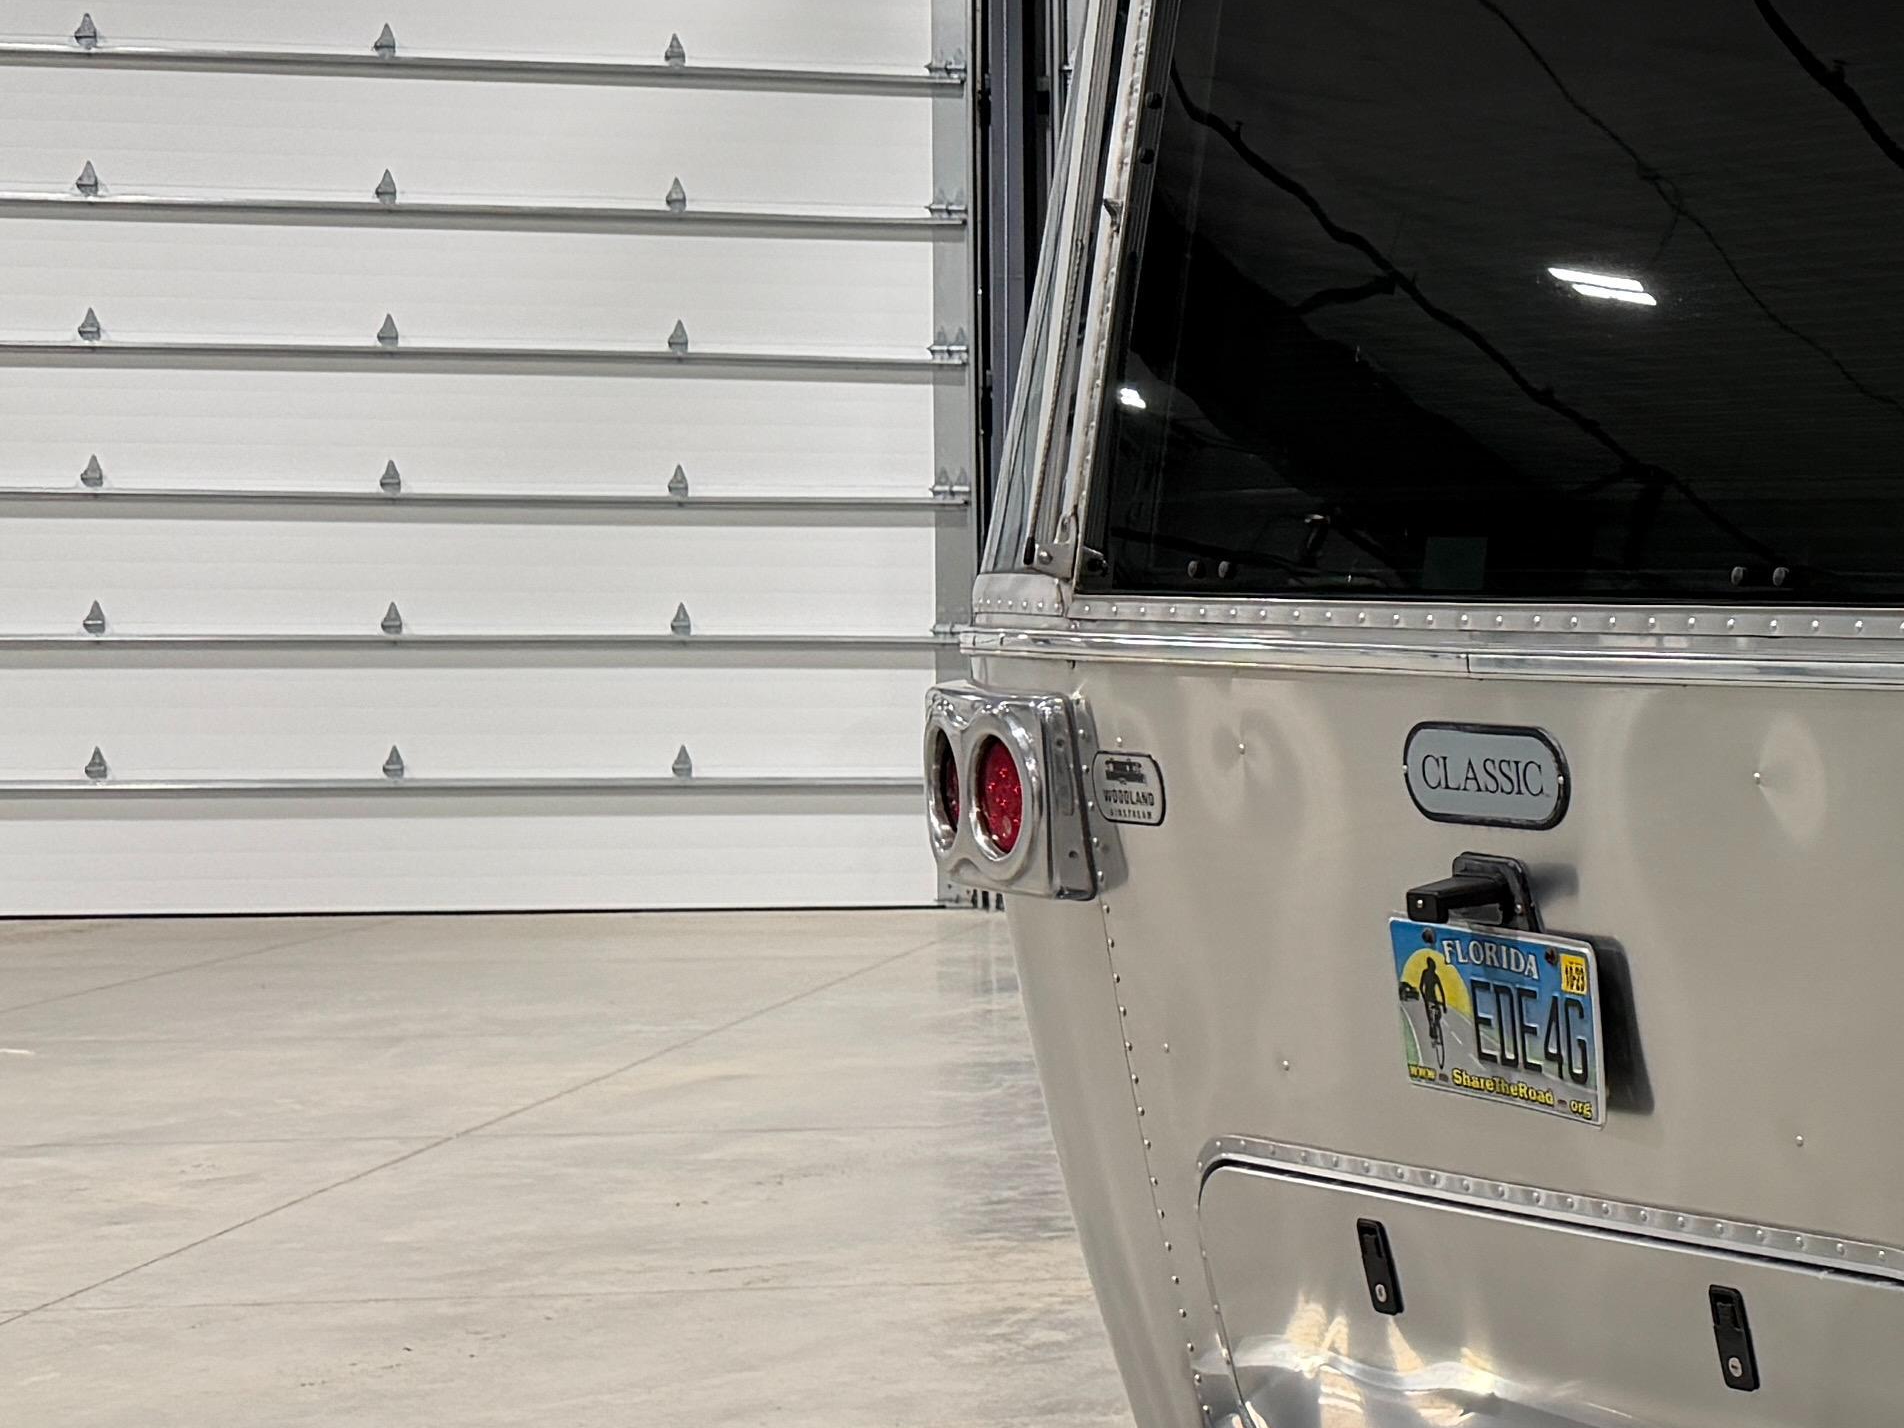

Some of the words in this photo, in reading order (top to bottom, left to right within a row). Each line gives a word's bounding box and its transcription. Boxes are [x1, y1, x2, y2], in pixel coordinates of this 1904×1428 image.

[1421, 754, 1543, 797] CLASSIC
[1103, 788, 1155, 807] WOODLAND
[1442, 939, 1540, 980] FLORIDA
[1471, 979, 1588, 1085] EDE4G
